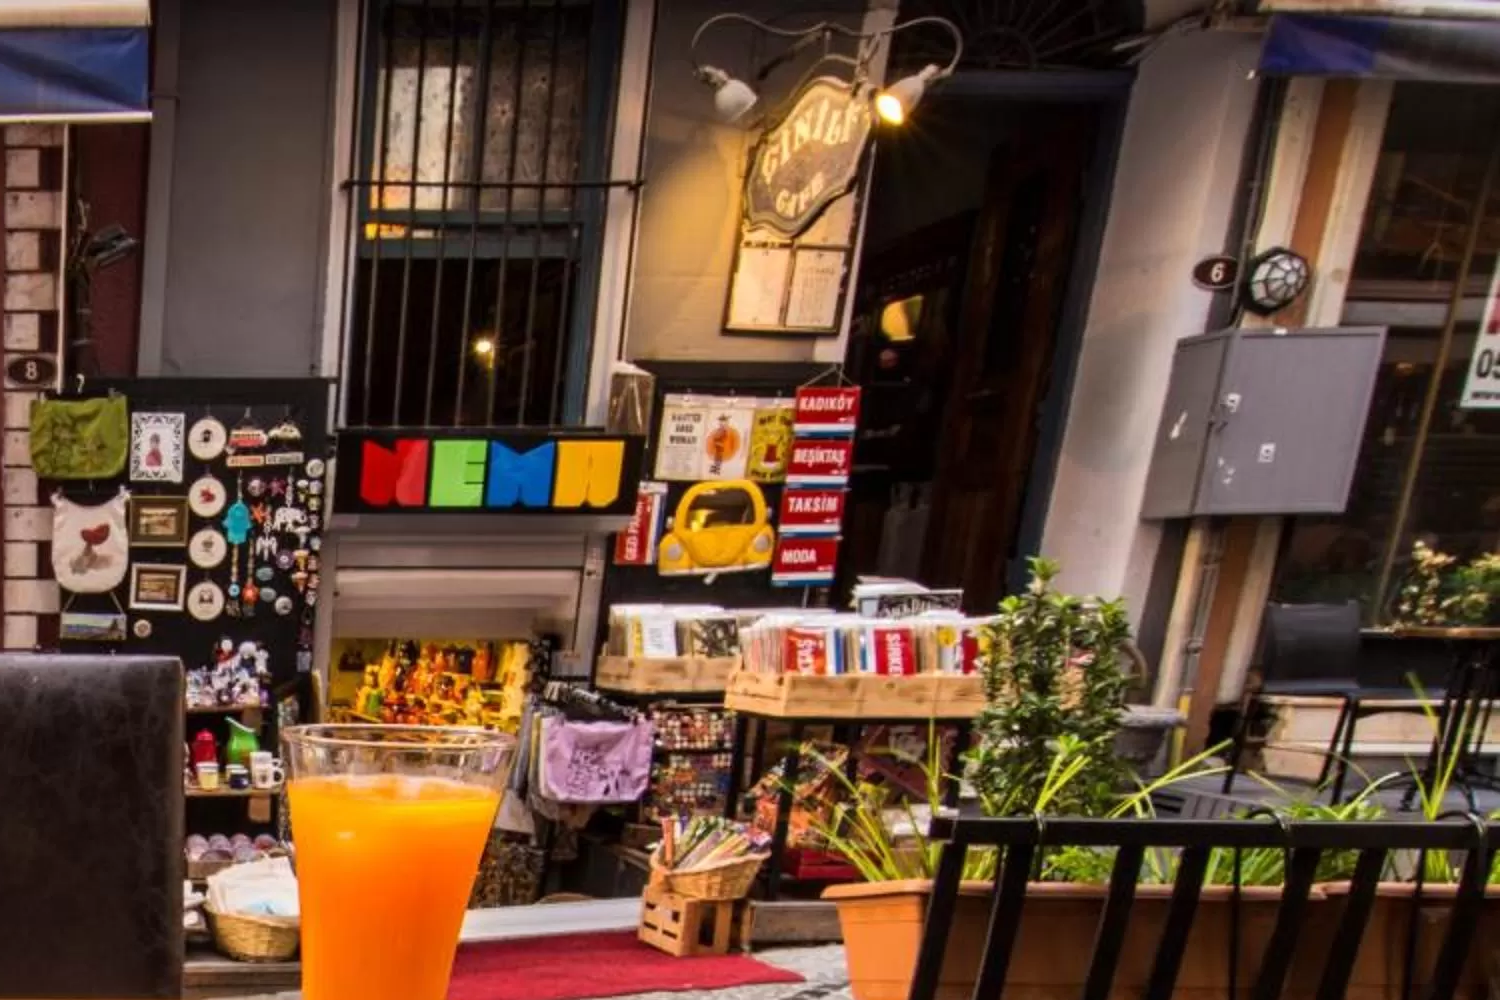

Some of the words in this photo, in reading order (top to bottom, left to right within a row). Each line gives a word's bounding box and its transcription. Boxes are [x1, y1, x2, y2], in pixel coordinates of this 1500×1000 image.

[1211, 262, 1225, 283] 6
[25, 360, 38, 380] 8
[799, 393, 856, 411] KADIKÖY
[793, 446, 846, 468] BEŞİKTAŞ
[787, 492, 839, 513] TAKSİM
[781, 547, 817, 565] MODA
